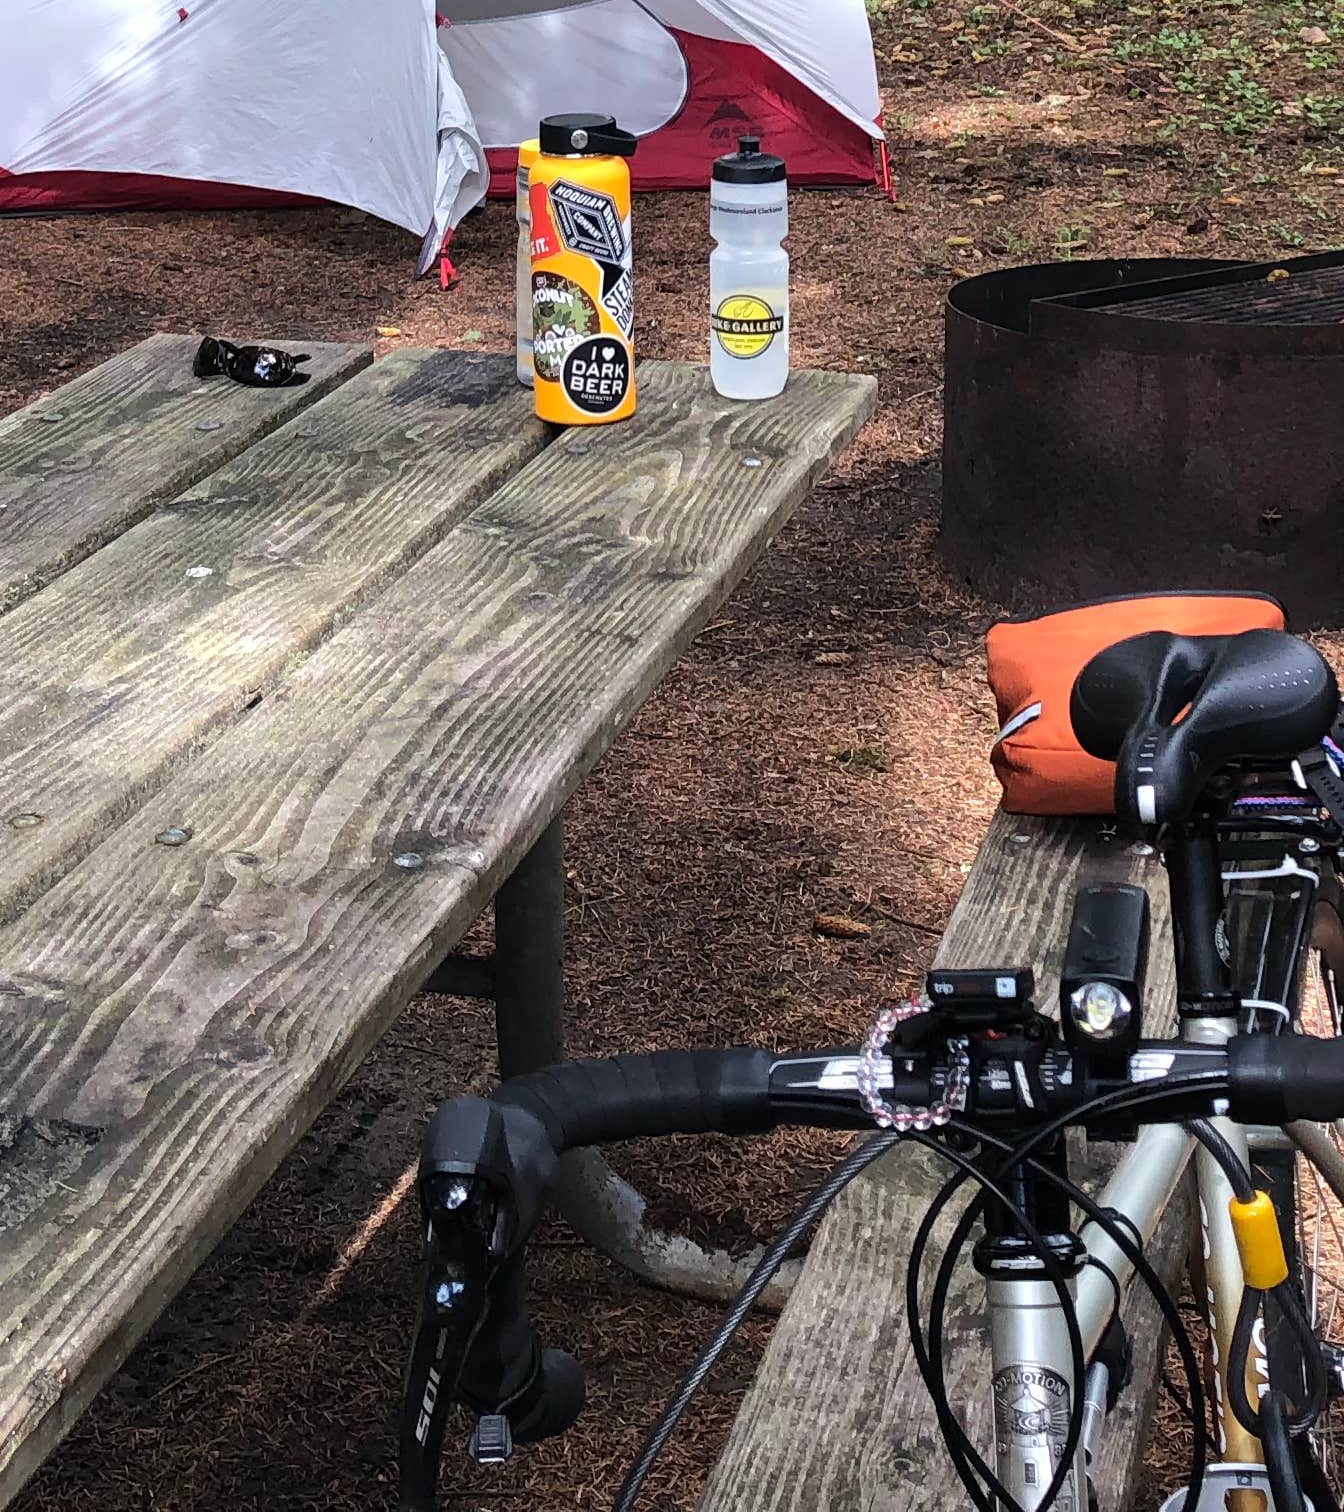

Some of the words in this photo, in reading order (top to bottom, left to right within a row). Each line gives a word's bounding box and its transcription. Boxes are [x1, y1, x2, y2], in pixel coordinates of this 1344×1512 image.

[555, 185, 607, 209] HOQUIAM
[603, 204, 624, 257] BREWING
[573, 211, 603, 241] COMPANY
[732, 318, 783, 333] GALLERY
[591, 346, 597, 361] I
[571, 359, 625, 379] DARK
[570, 376, 623, 396] BEER
[415, 1367, 441, 1447] 105
